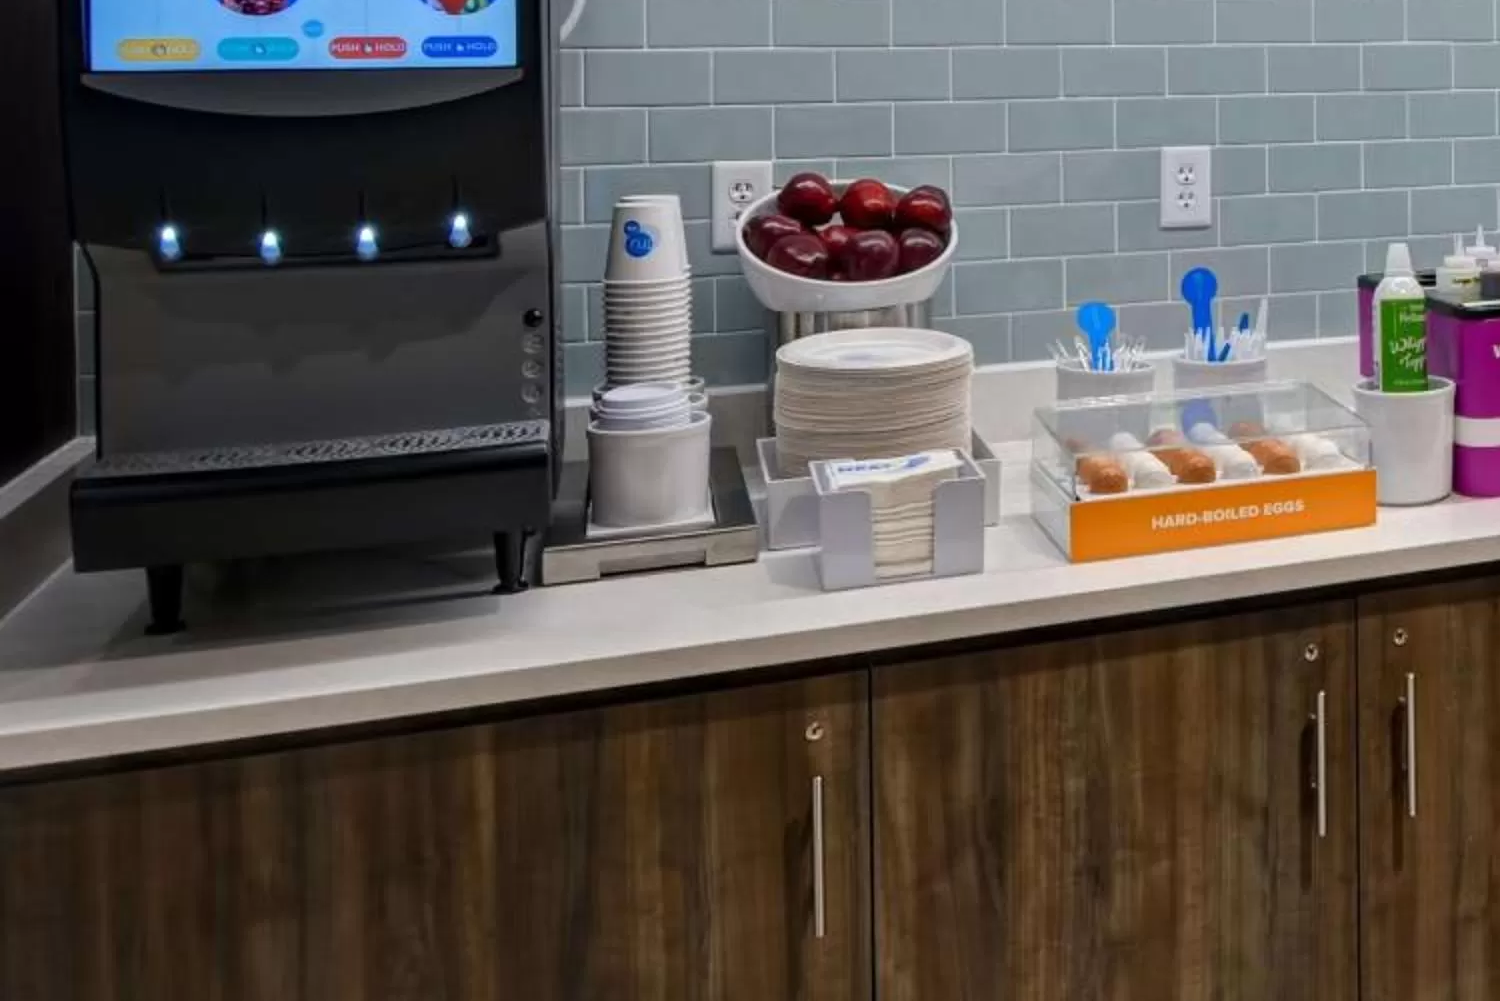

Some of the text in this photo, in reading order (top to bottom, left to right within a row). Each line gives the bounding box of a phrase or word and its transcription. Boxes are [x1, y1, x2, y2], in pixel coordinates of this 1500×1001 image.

[332, 42, 405, 52] PUSH HOLD
[1151, 499, 1305, 530] HARD-BOILED EGGS
